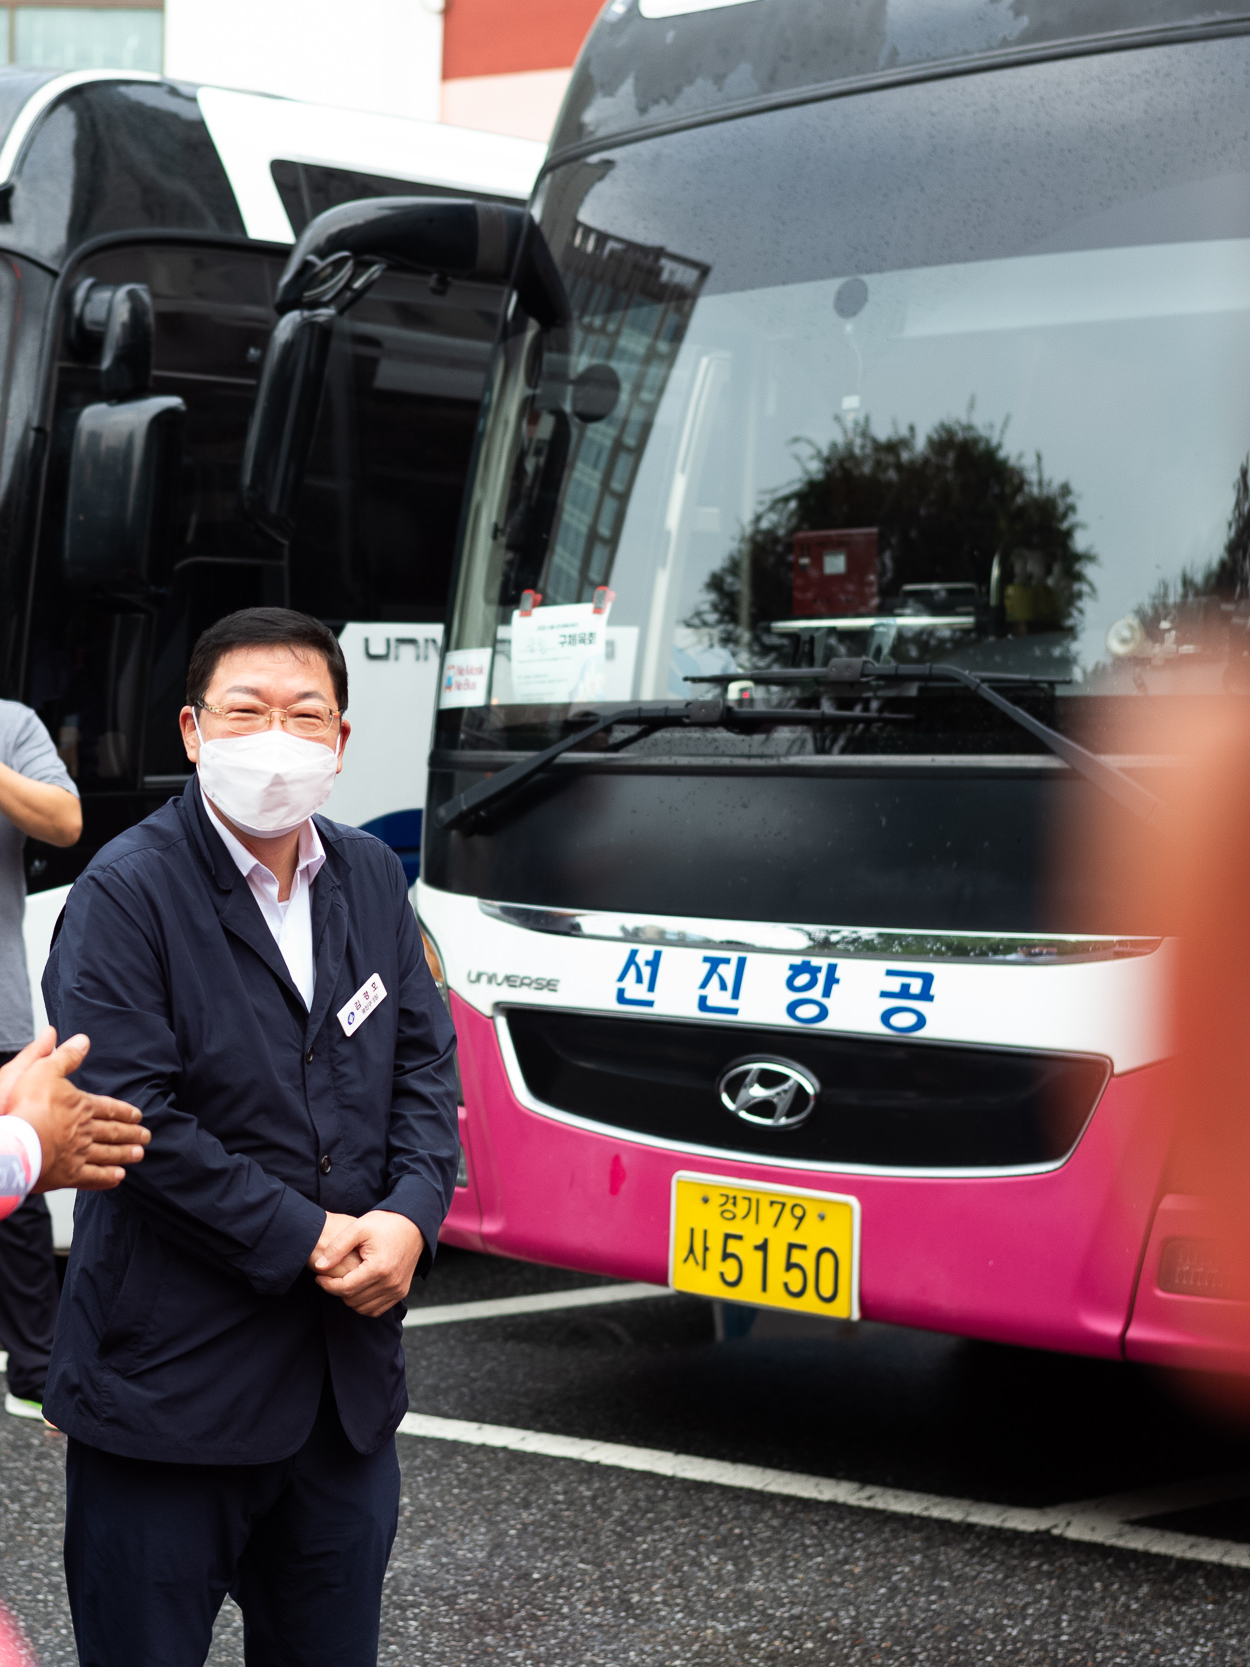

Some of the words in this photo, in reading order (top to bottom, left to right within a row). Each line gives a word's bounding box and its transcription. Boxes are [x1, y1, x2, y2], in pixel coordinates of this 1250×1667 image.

[558, 631, 596, 648] 구체육회
[466, 968, 561, 993] UNIVERSE
[615, 947, 935, 1035] 선진항공
